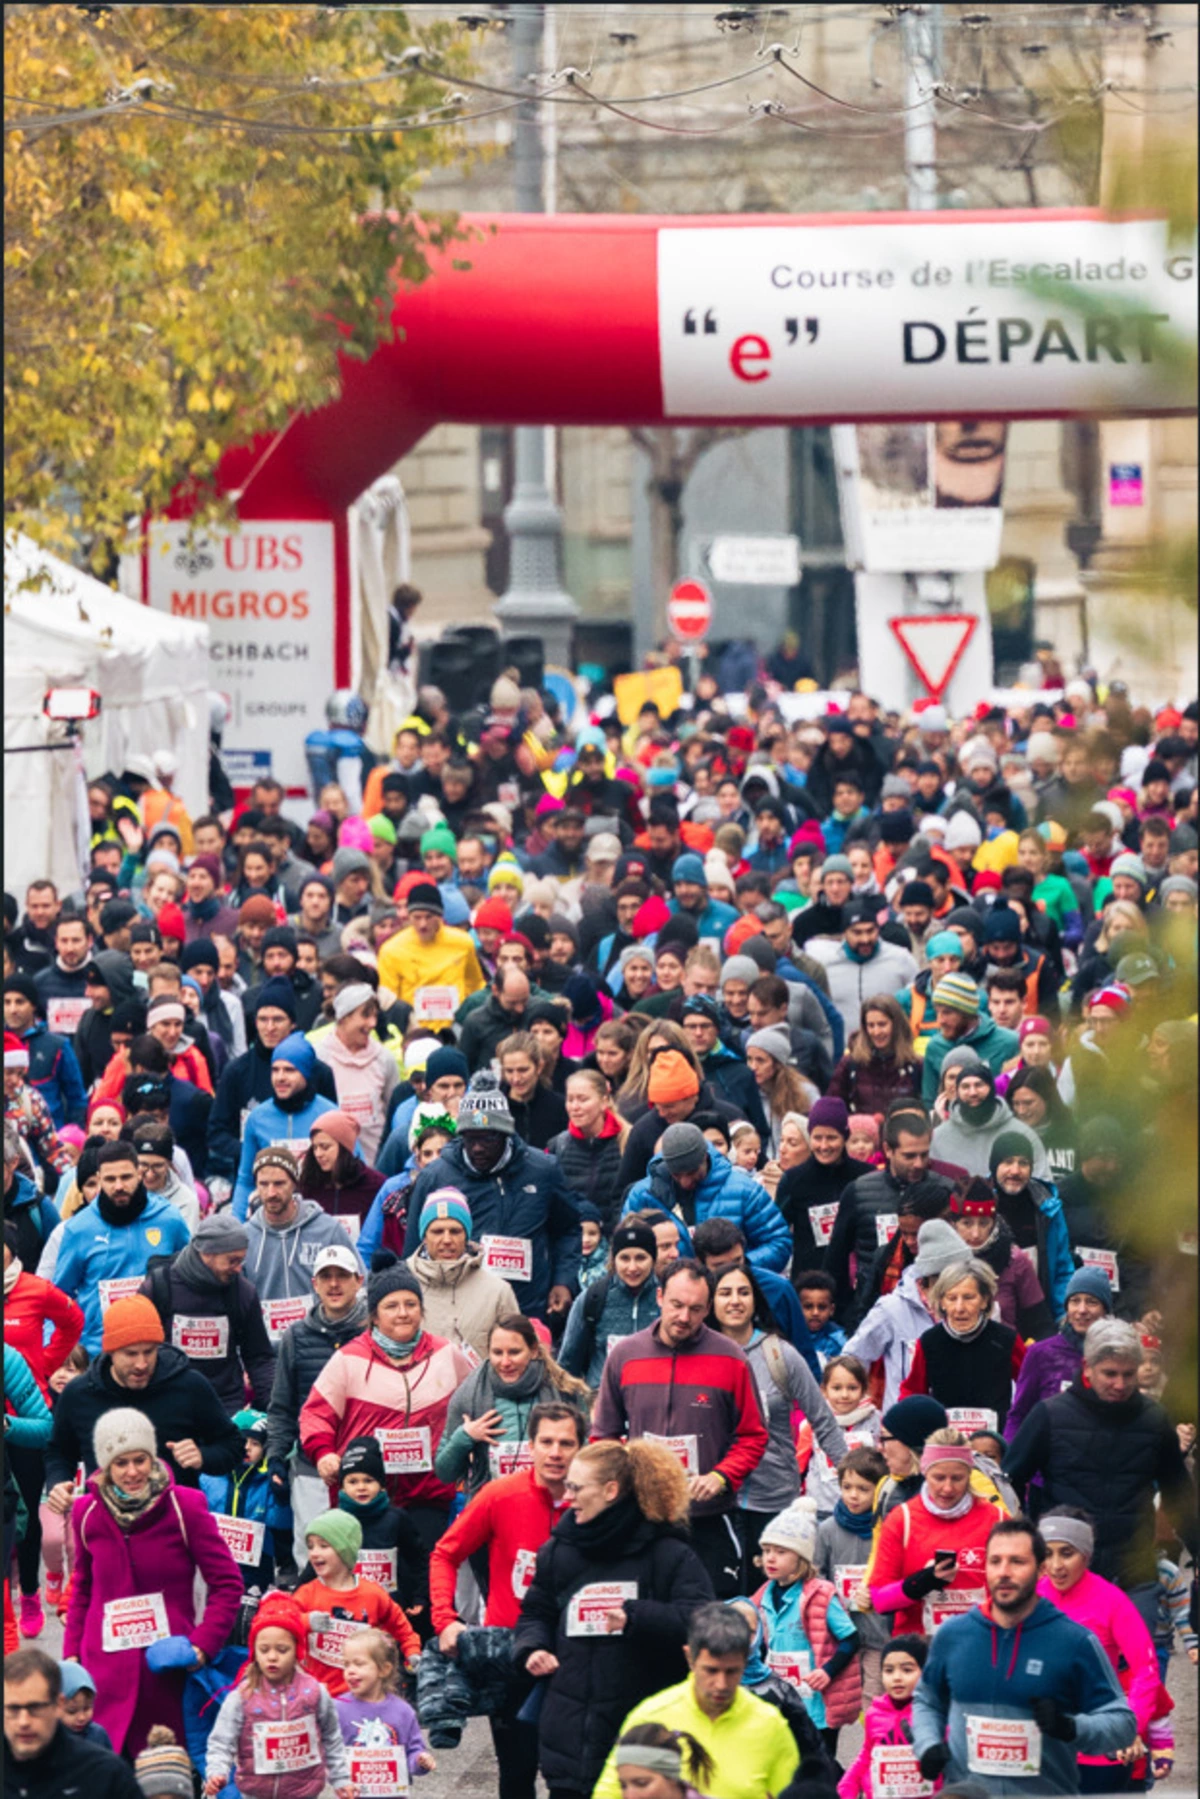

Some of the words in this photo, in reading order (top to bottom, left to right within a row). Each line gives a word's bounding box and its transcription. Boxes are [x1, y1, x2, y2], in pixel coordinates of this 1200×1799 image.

[770, 264, 895, 290] Course
[910, 260, 953, 287] de
[902, 305, 1170, 365] DÉPART
[222, 534, 304, 573] UBS
[170, 590, 310, 620] MIGROS
[244, 702, 308, 717] GROUPE
[492, 1238, 523, 1248] MIGROS
[196, 1319, 217, 1329] UBS
[963, 1410, 984, 1420] UBS
[386, 1429, 421, 1441] MIGROS
[366, 1551, 389, 1562] UBS
[583, 1585, 622, 1596] MIGROS
[948, 1590, 974, 1601] UBS
[112, 1597, 152, 1611] MIGROS
[130, 1634, 154, 1646] UBS
[267, 1722, 308, 1735] MIGROS
[980, 1722, 1026, 1734] MIGROS
[270, 1745, 309, 1760] 10577
[353, 1747, 395, 1759] MIGROS
[981, 1747, 1025, 1762] 10735
[286, 1758, 309, 1770] UBS
[369, 1783, 393, 1795] UBS
[897, 1784, 920, 1796] UBS
